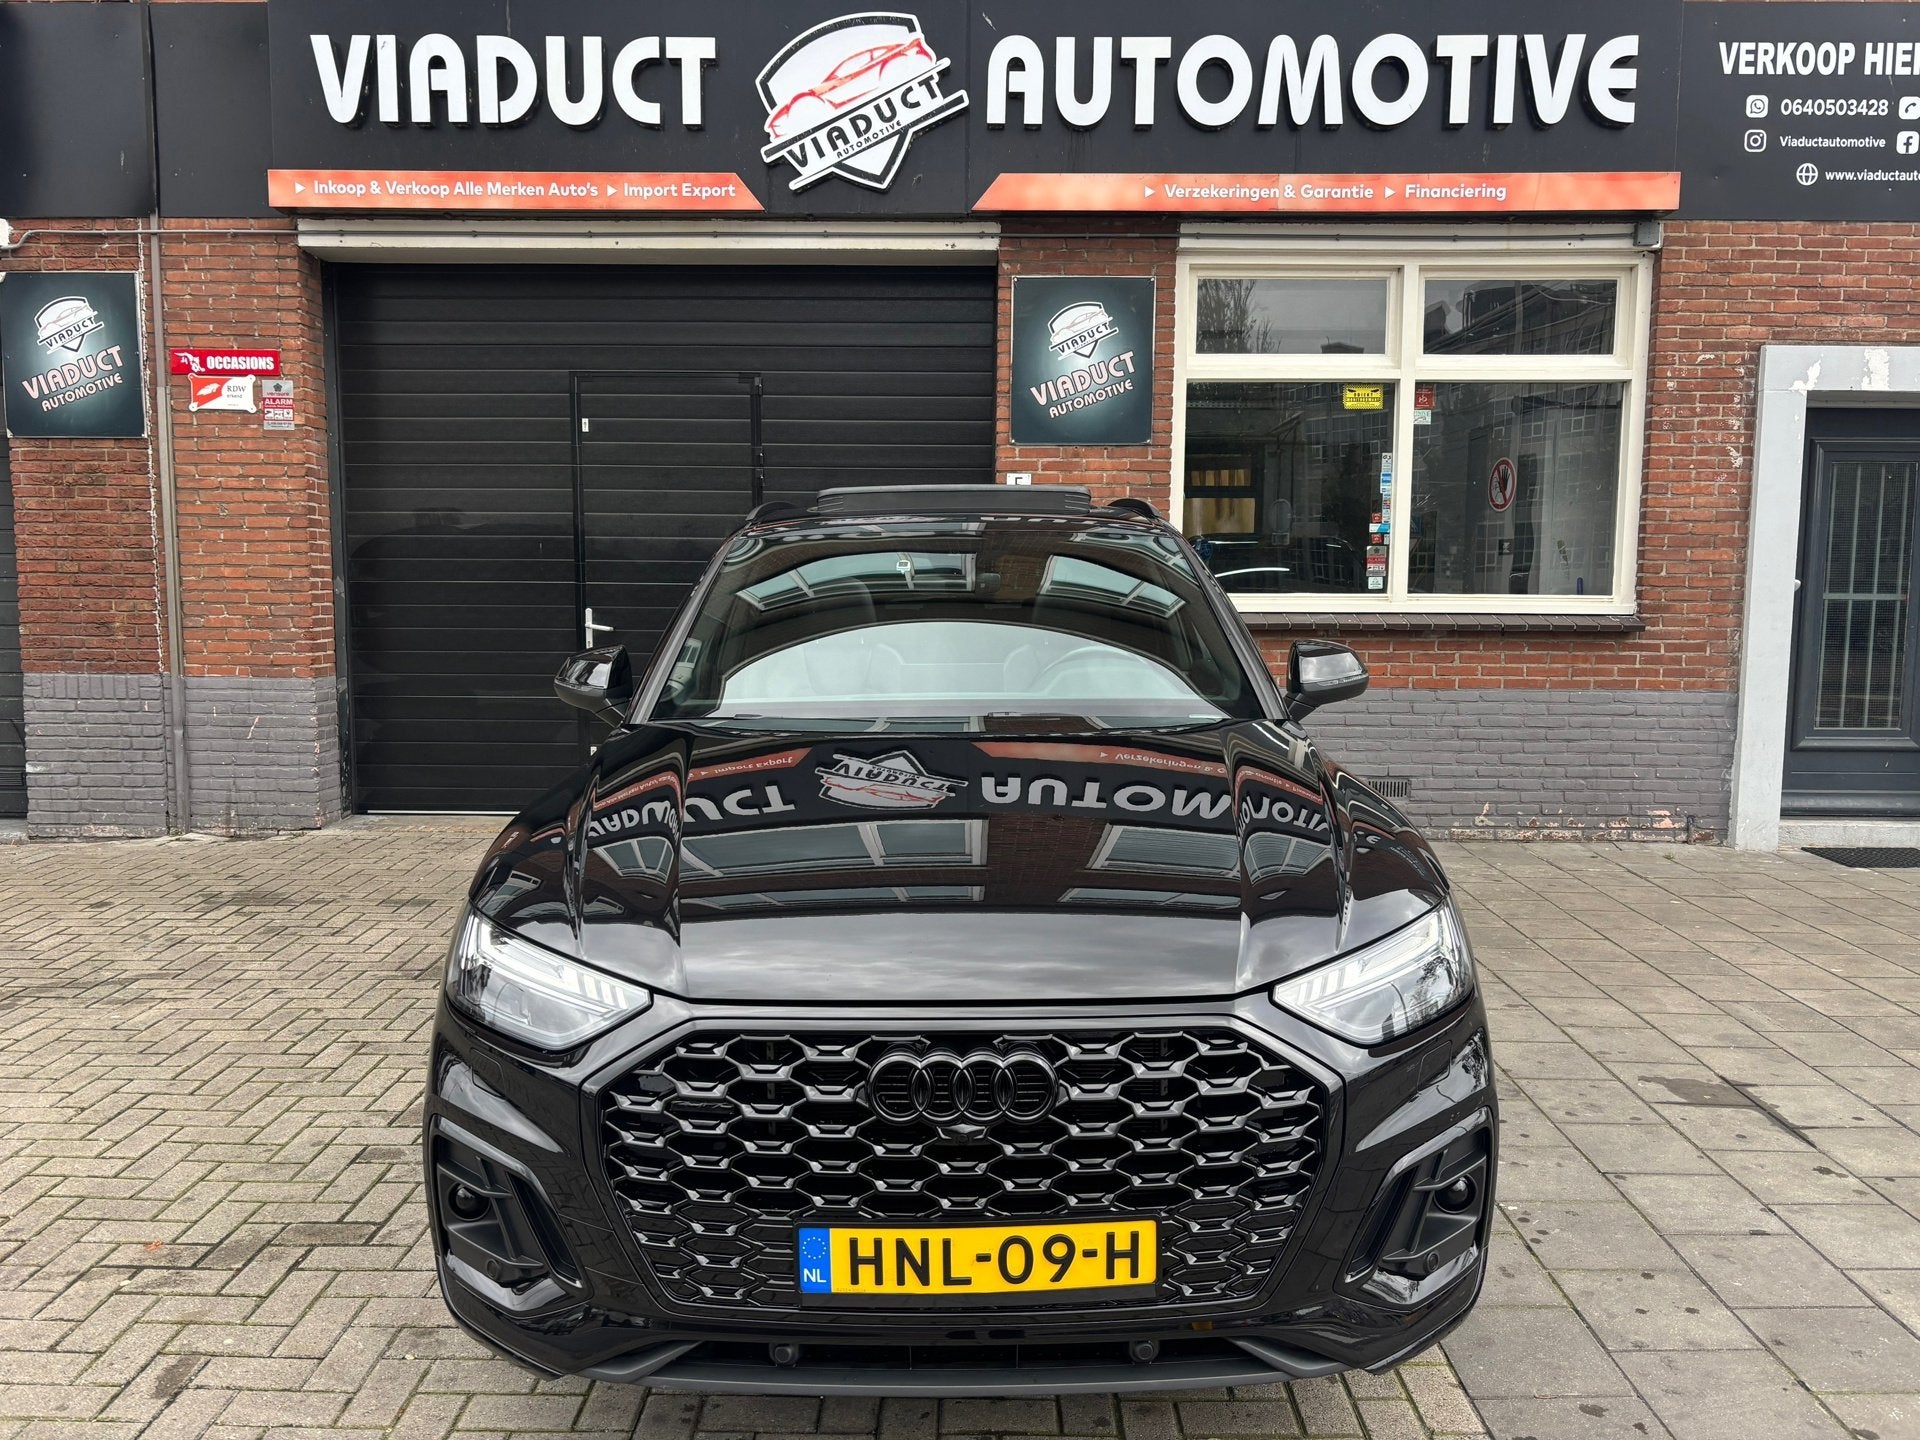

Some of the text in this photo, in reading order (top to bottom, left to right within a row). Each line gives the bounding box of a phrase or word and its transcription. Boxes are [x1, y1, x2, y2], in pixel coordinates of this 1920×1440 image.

[1719, 42, 1920, 75] VERKOOP HIE
[310, 33, 1639, 126] VIADUCT AUTOMOTIVE
[786, 75, 938, 168] VIADUCT
[1780, 98, 1889, 116] 0640503428
[836, 119, 903, 159] AUTOMOTIVE
[1779, 135, 1887, 148] Viaductautomotive
[314, 180, 599, 198] Inkoop & Verkoop Alle Merken Auto's
[624, 183, 736, 199] Import Export
[1165, 184, 1374, 201] Verzekeringen & Garantie
[1405, 183, 1507, 201] Financiering
[46, 317, 95, 347] VIADUCT
[1058, 322, 1108, 353] VIADUCT
[22, 345, 124, 399] VIADUCT
[206, 356, 275, 370] OCCASIONS
[1030, 351, 1135, 406] VIADUCT
[42, 373, 123, 412] AUTOMOTIVE
[1049, 379, 1133, 418] AUTOMOTIVE
[849, 1230, 1140, 1286] HNL-09-H
[803, 1268, 827, 1283] NL
